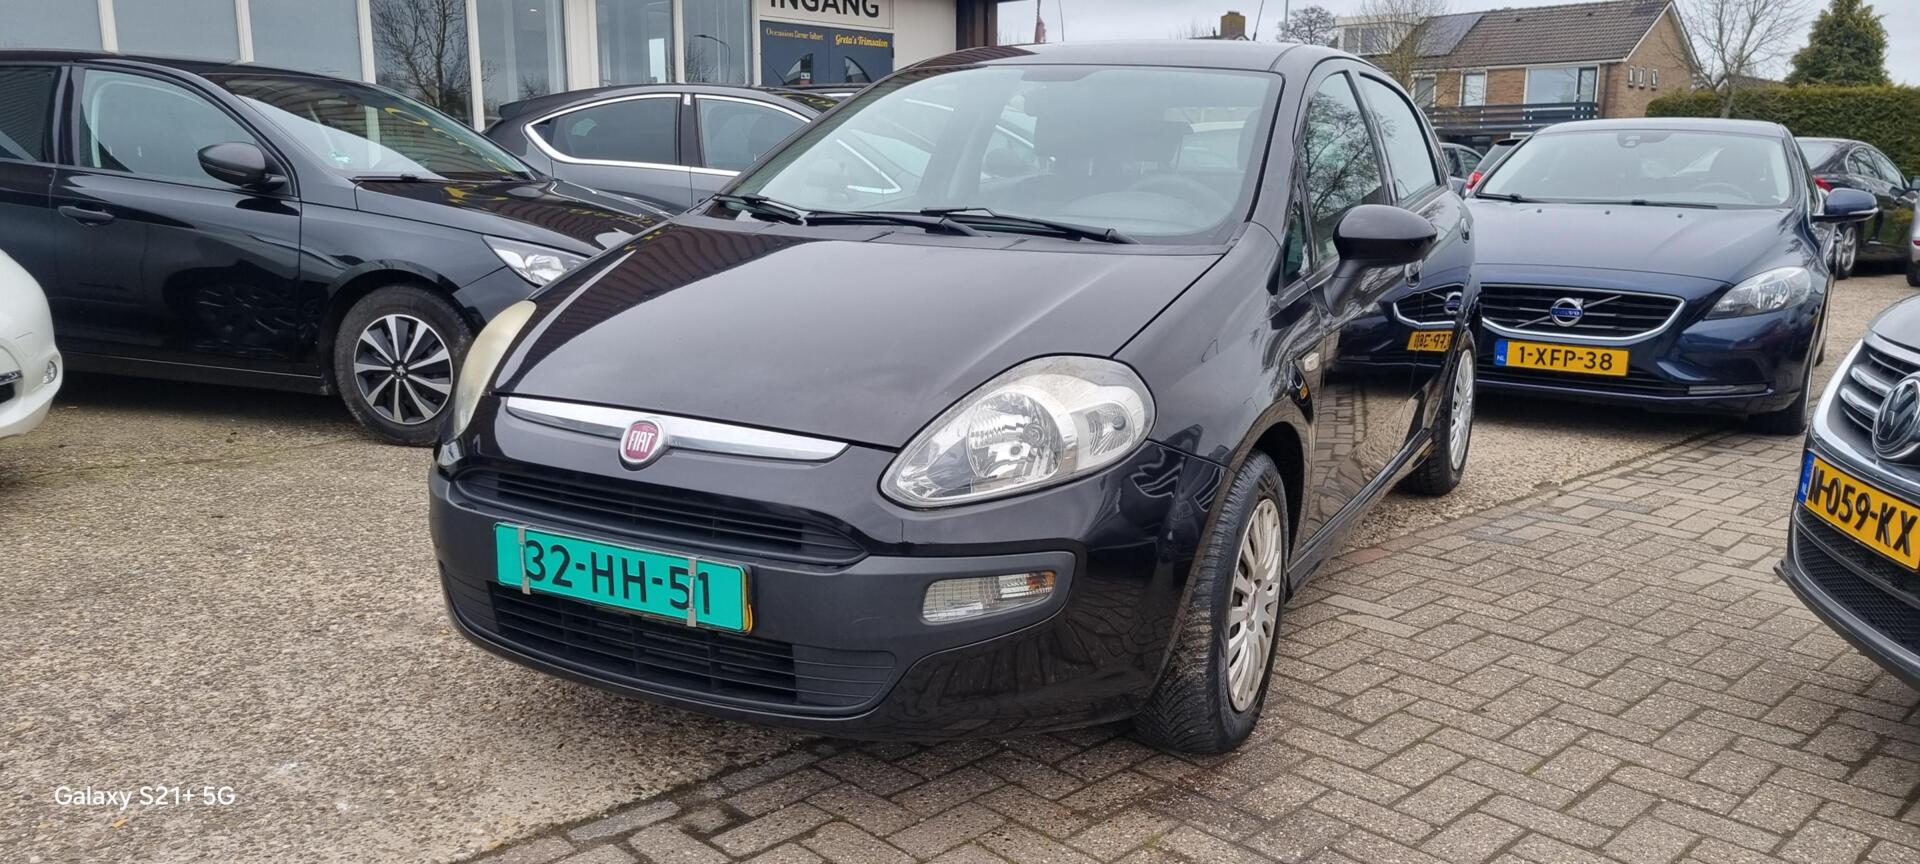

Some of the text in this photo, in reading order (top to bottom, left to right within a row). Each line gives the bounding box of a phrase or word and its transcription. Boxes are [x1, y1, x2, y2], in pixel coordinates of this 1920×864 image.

[1519, 346, 1613, 371] 1-XFP-38
[627, 430, 655, 453] FIAT
[1808, 466, 1918, 556] N-059-KX
[525, 540, 710, 615] 32-HH-51
